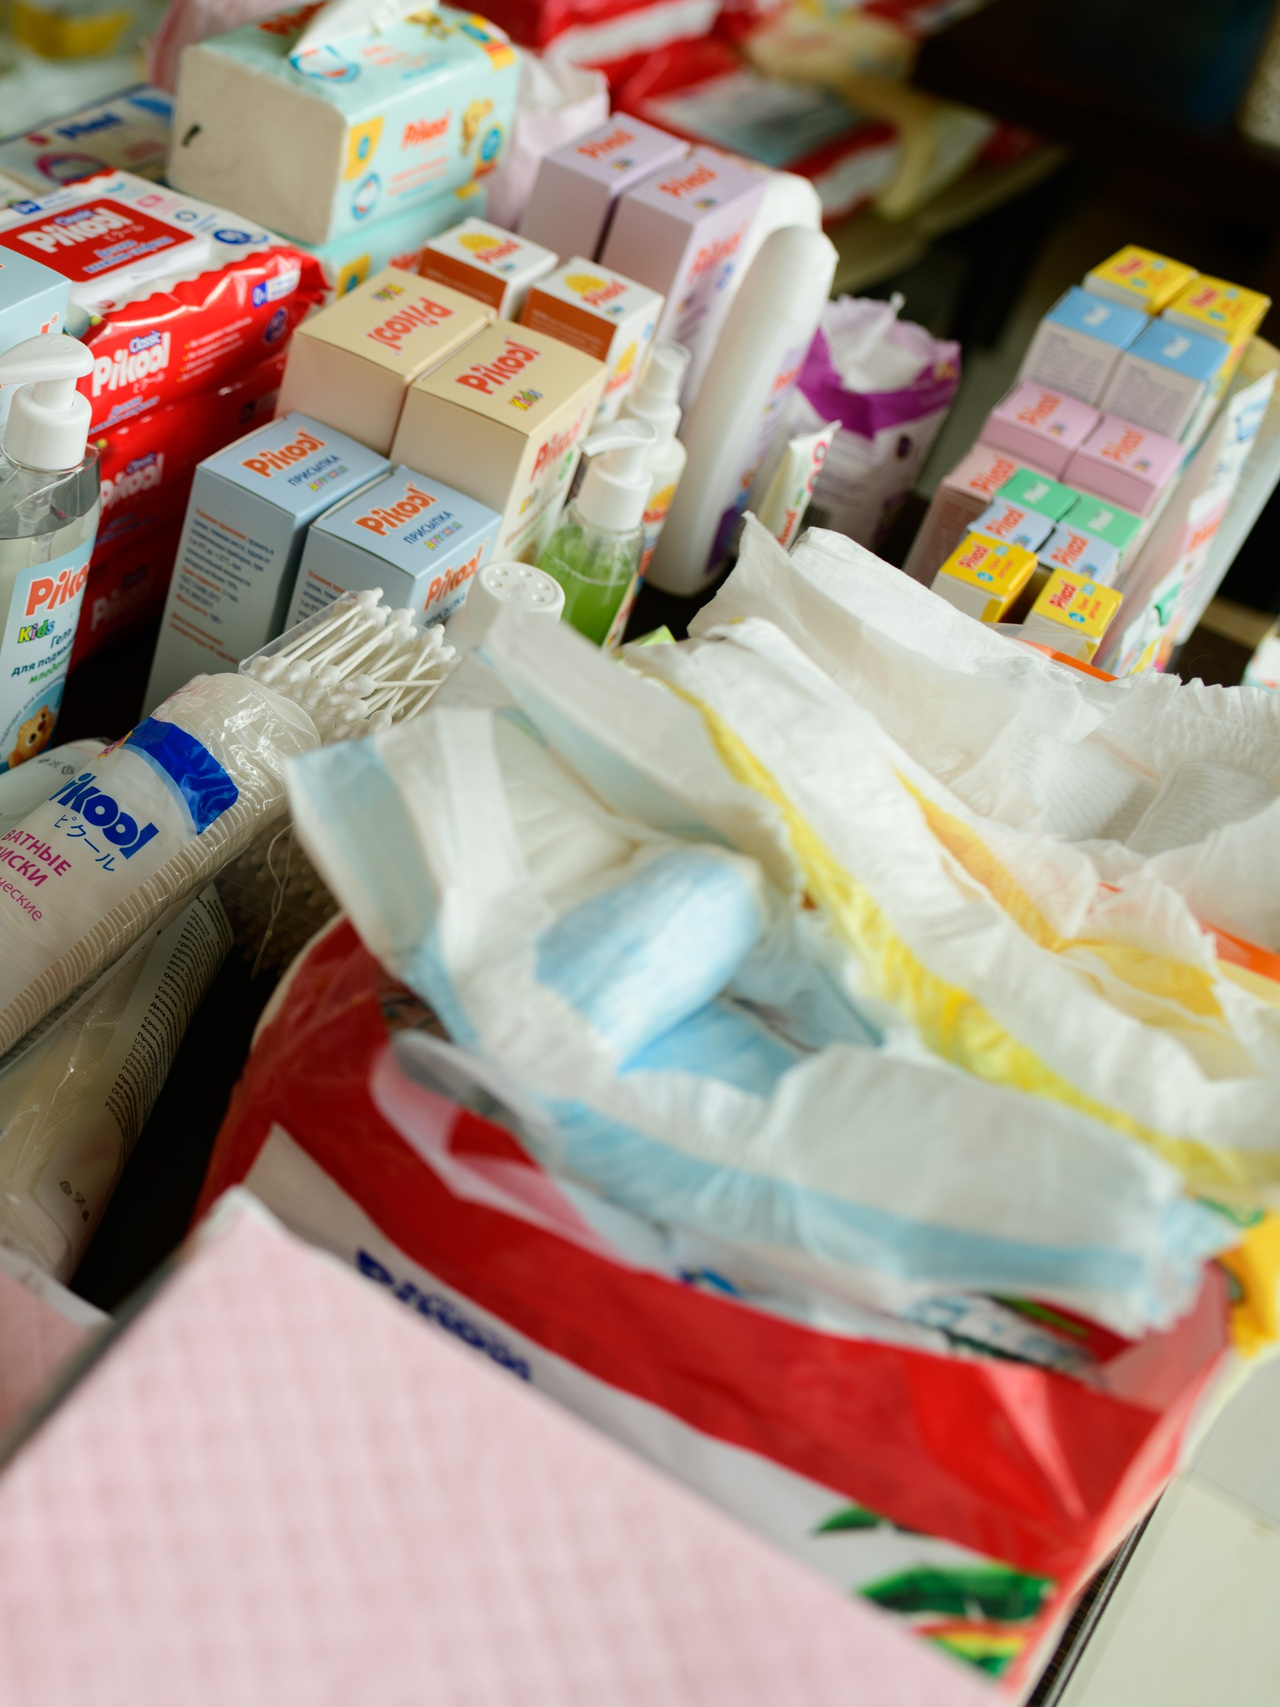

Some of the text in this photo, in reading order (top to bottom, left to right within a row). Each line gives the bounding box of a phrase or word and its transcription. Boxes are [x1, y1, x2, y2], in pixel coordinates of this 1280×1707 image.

[367, 296, 455, 353] Pikool
[92, 331, 171, 397] Pikool
[456, 340, 542, 396] Pikool
[242, 432, 327, 478] Pikool
[287, 455, 342, 487] ПРИСЫПКА
[355, 487, 439, 537] Pikool
[403, 510, 455, 545] ПРИСЫПКА
[424, 546, 484, 610] Pikool
[18, 620, 55, 644] Kids
[11, 663, 36, 678] для
[49, 772, 160, 860] ikool
[1, 828, 72, 877] ВАТНЫЕ
[54, 814, 116, 873] ピクール
